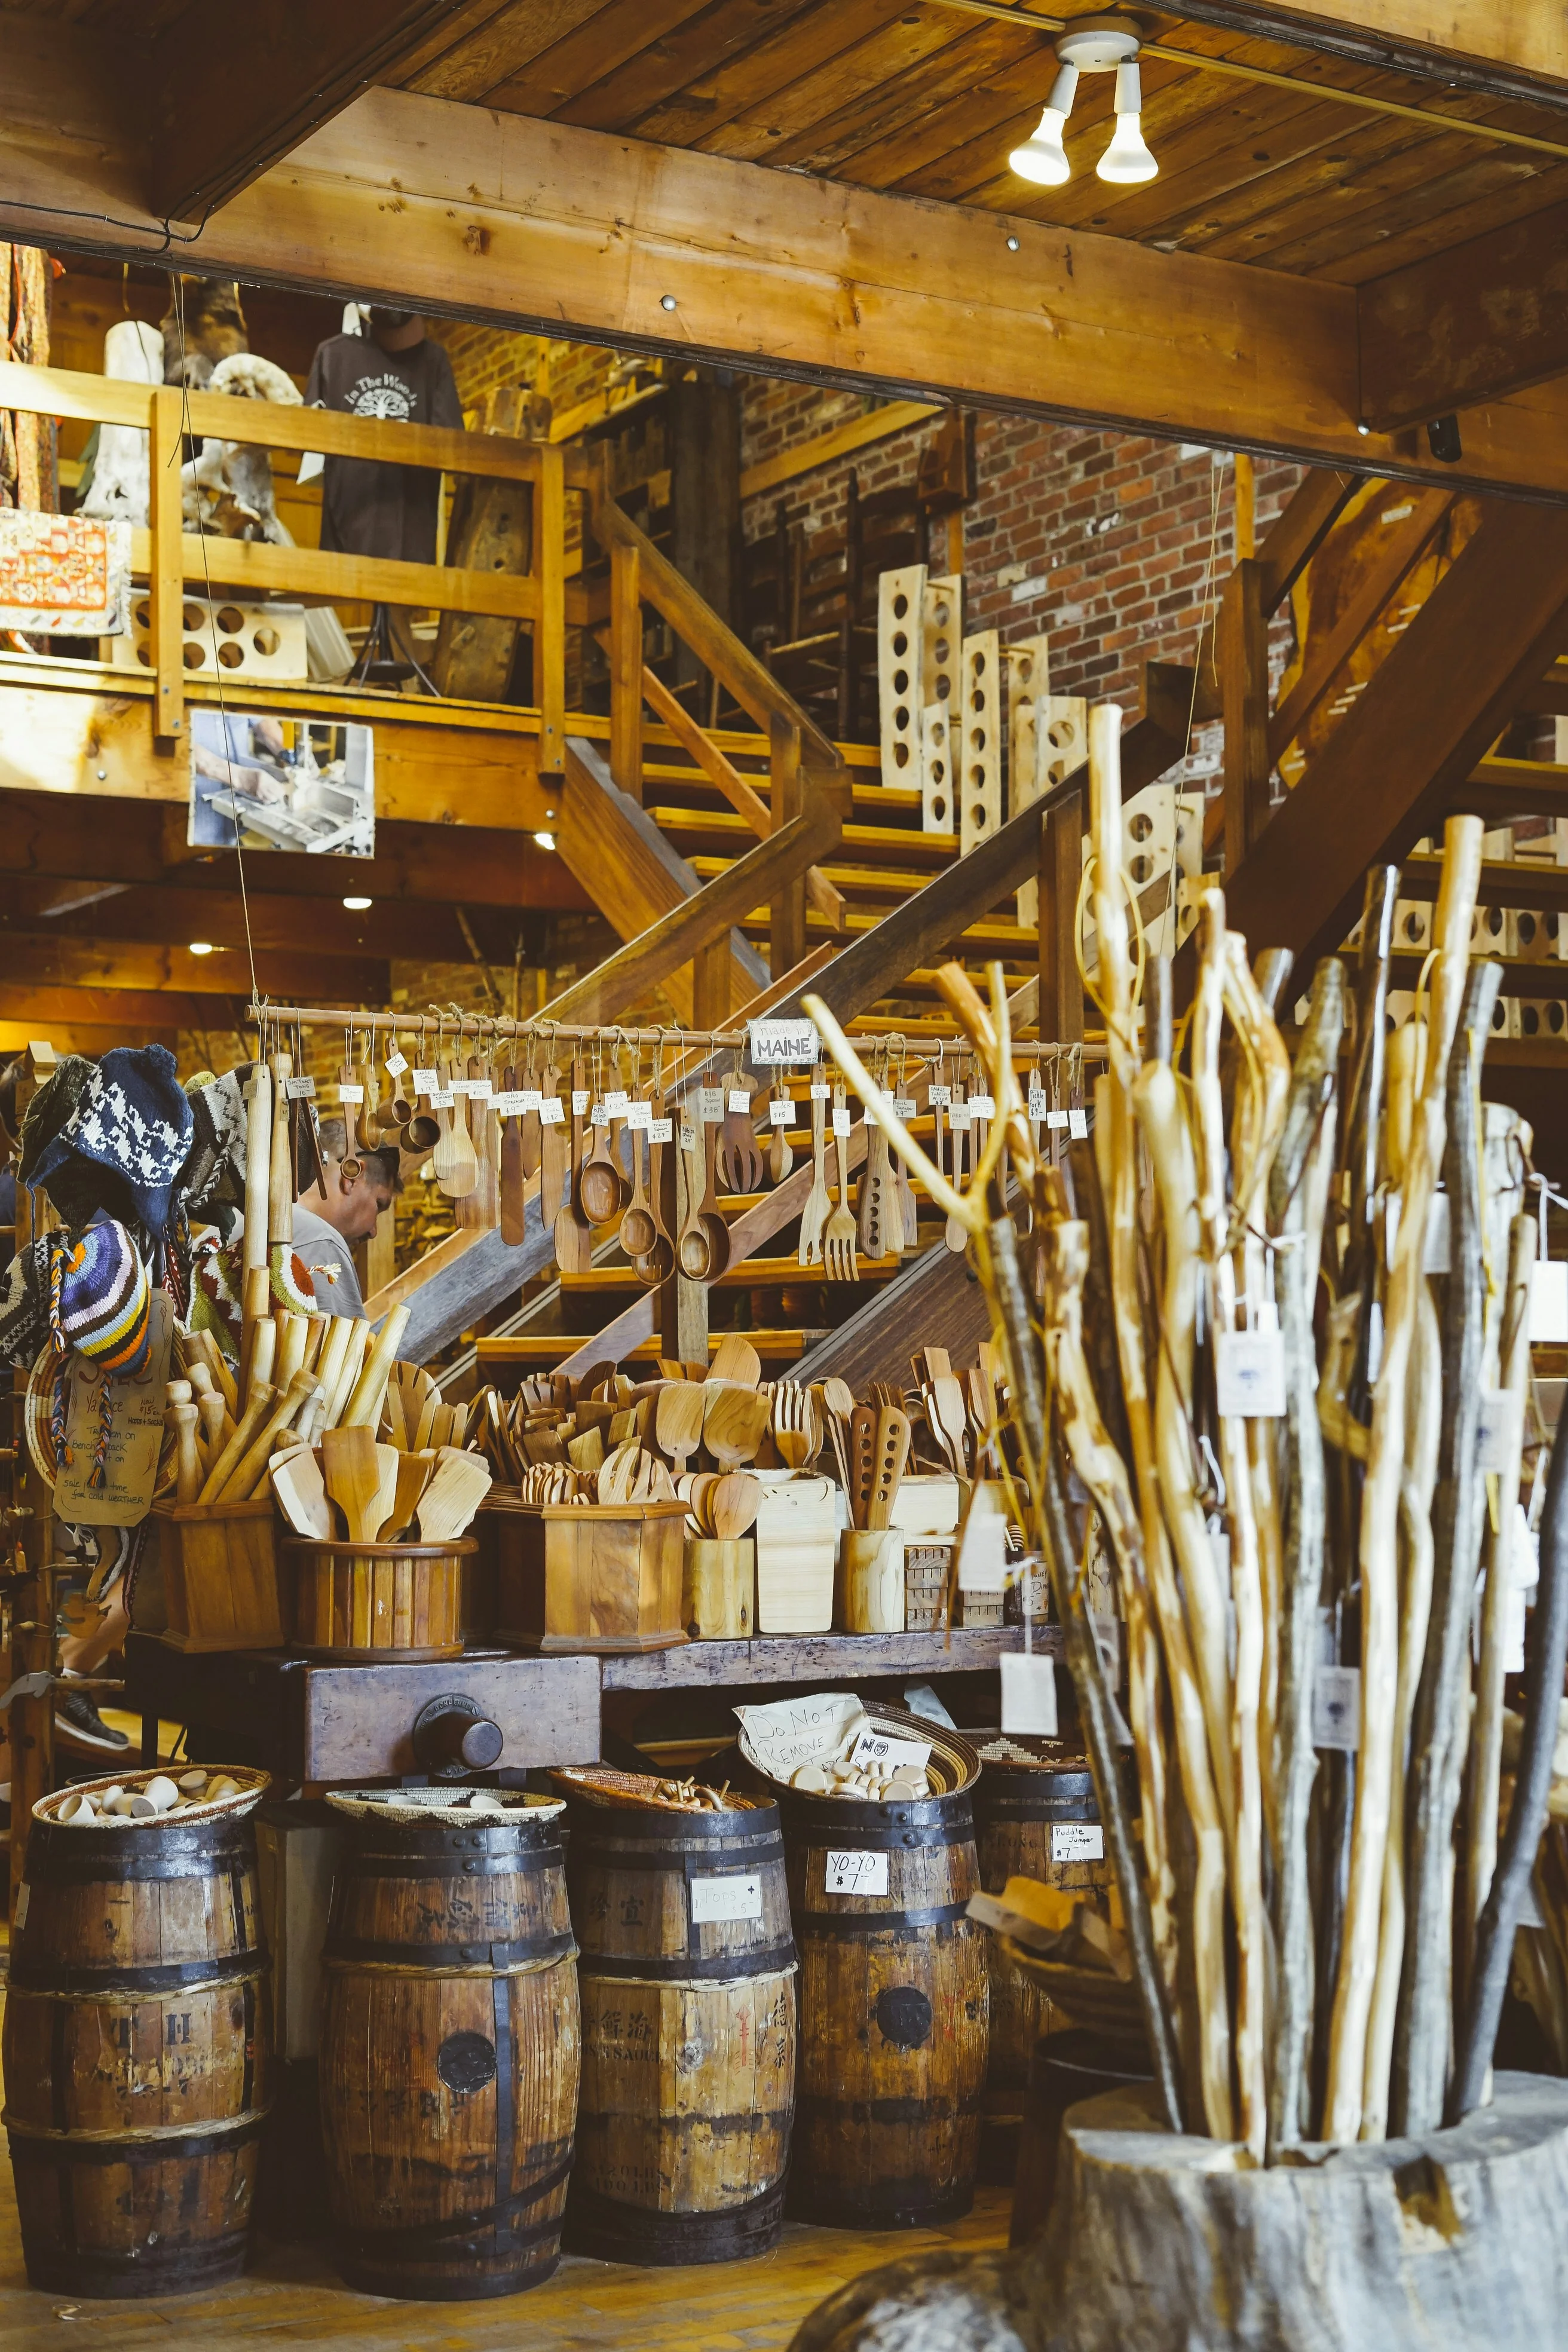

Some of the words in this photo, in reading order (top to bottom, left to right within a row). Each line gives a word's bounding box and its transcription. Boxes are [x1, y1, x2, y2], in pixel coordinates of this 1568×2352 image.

[355, 376, 382, 392] The
[760, 1024, 792, 1036] made
[796, 1025, 806, 1036] in
[1030, 1089, 1044, 1099] Pickle
[125, 1432, 136, 1441] on
[72, 1440, 96, 1451] Bench
[758, 1736, 825, 1765] REMOVE
[860, 1738, 889, 1757] NO
[1055, 1827, 1085, 1837] Puddle
[831, 1854, 876, 1873] YO-YO
[700, 1888, 737, 1905] Tops
